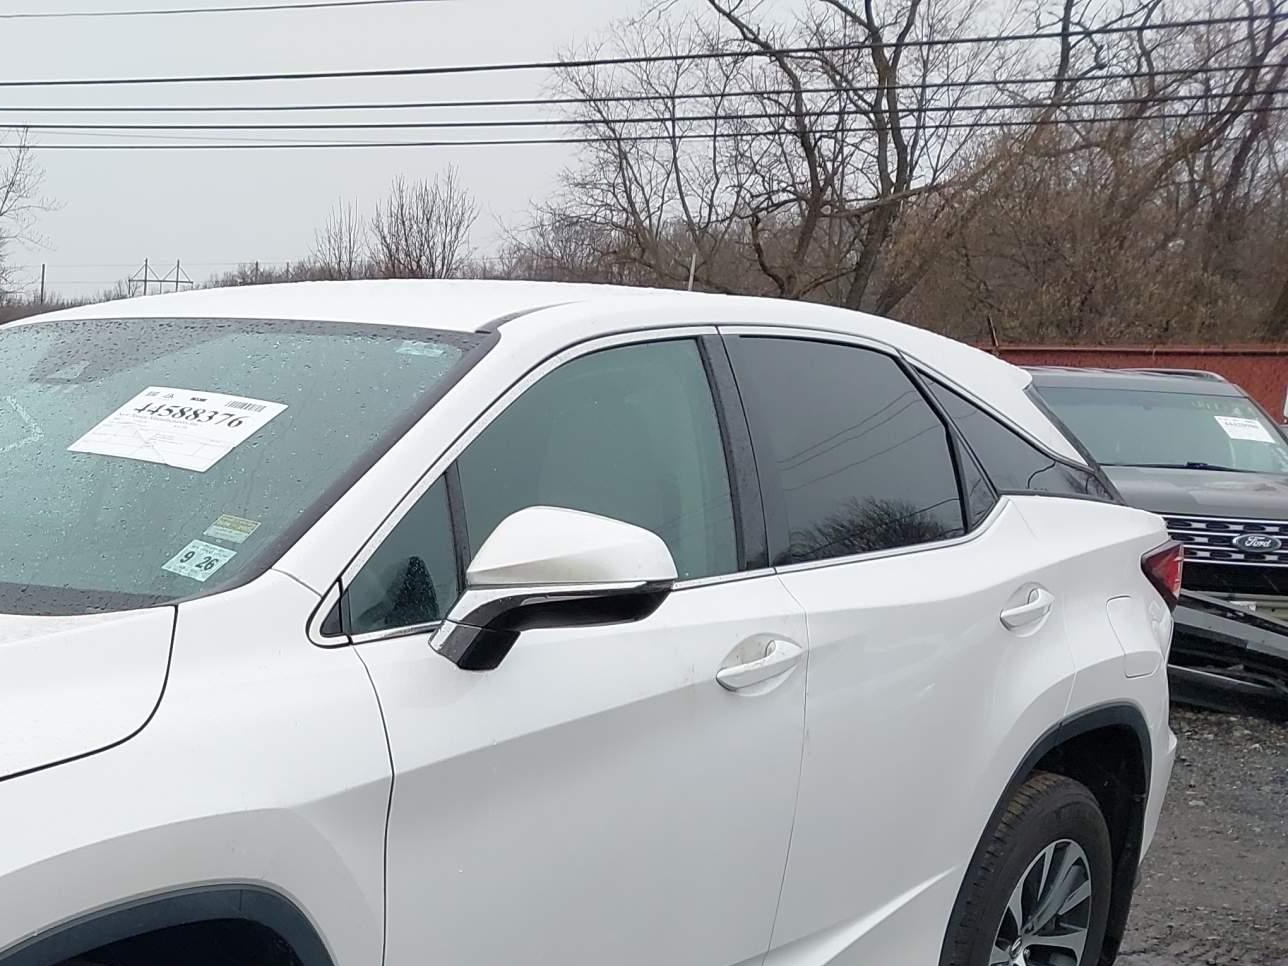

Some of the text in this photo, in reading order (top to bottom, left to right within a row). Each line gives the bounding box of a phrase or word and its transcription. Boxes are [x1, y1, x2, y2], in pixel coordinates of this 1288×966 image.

[135, 402, 249, 429] 44588376
[1244, 535, 1272, 549] Ford
[179, 550, 219, 571] 9 26
